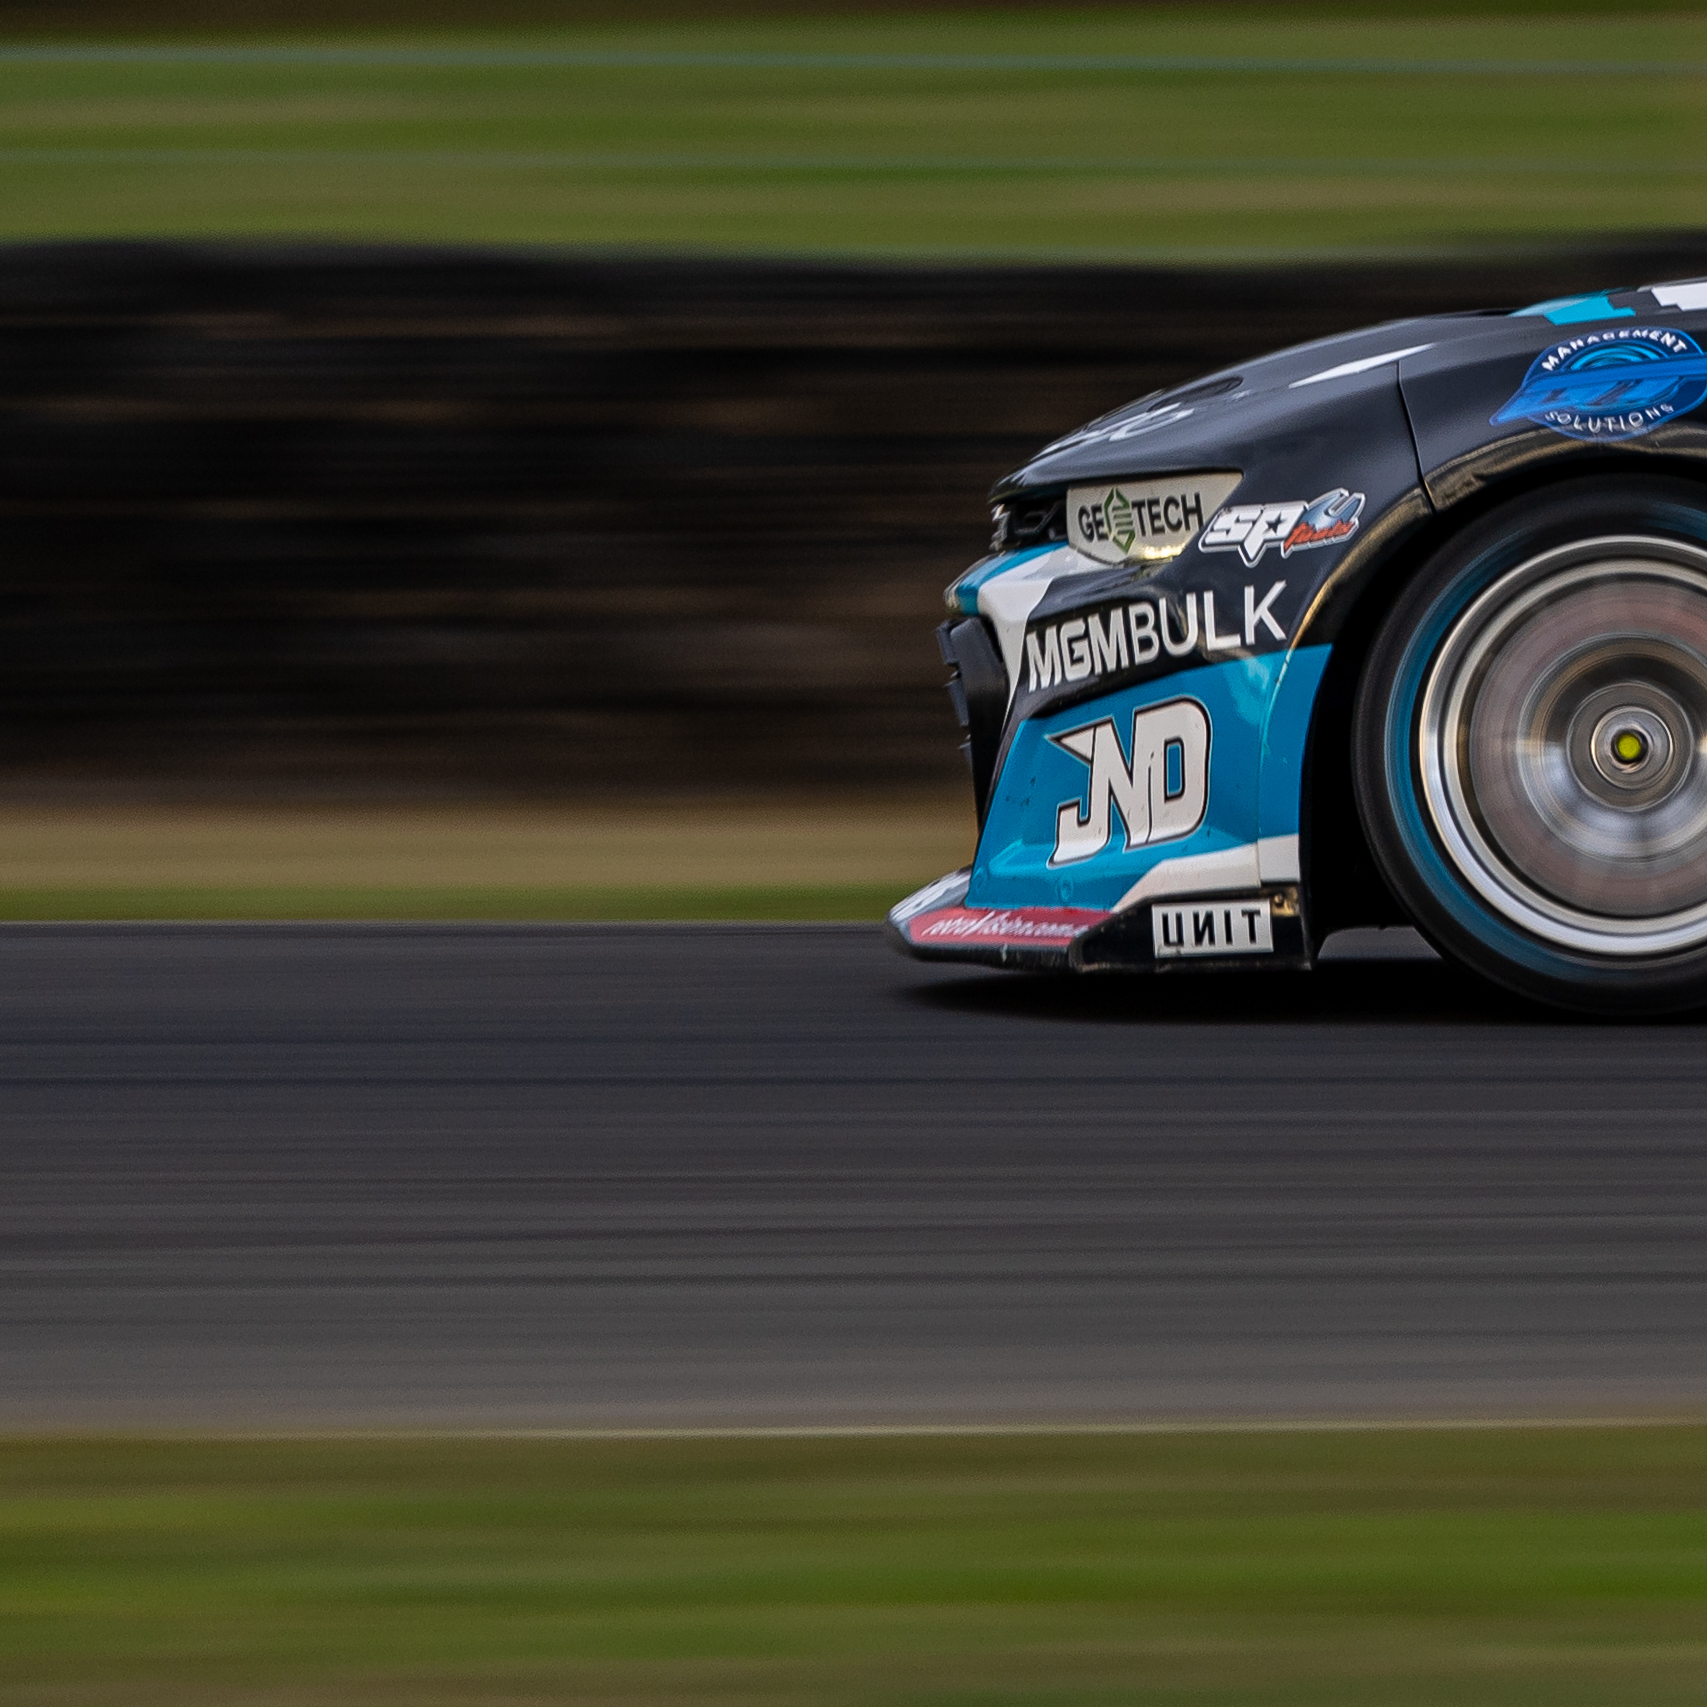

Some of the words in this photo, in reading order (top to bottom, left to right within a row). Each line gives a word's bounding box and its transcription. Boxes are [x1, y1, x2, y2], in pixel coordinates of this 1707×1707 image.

[1542, 330, 1687, 371] MANAGEMENT
[1544, 403, 1674, 433] SOLUTIONS
[1026, 580, 1286, 694] MGMBULK
[1162, 909, 1261, 947] UNIT
